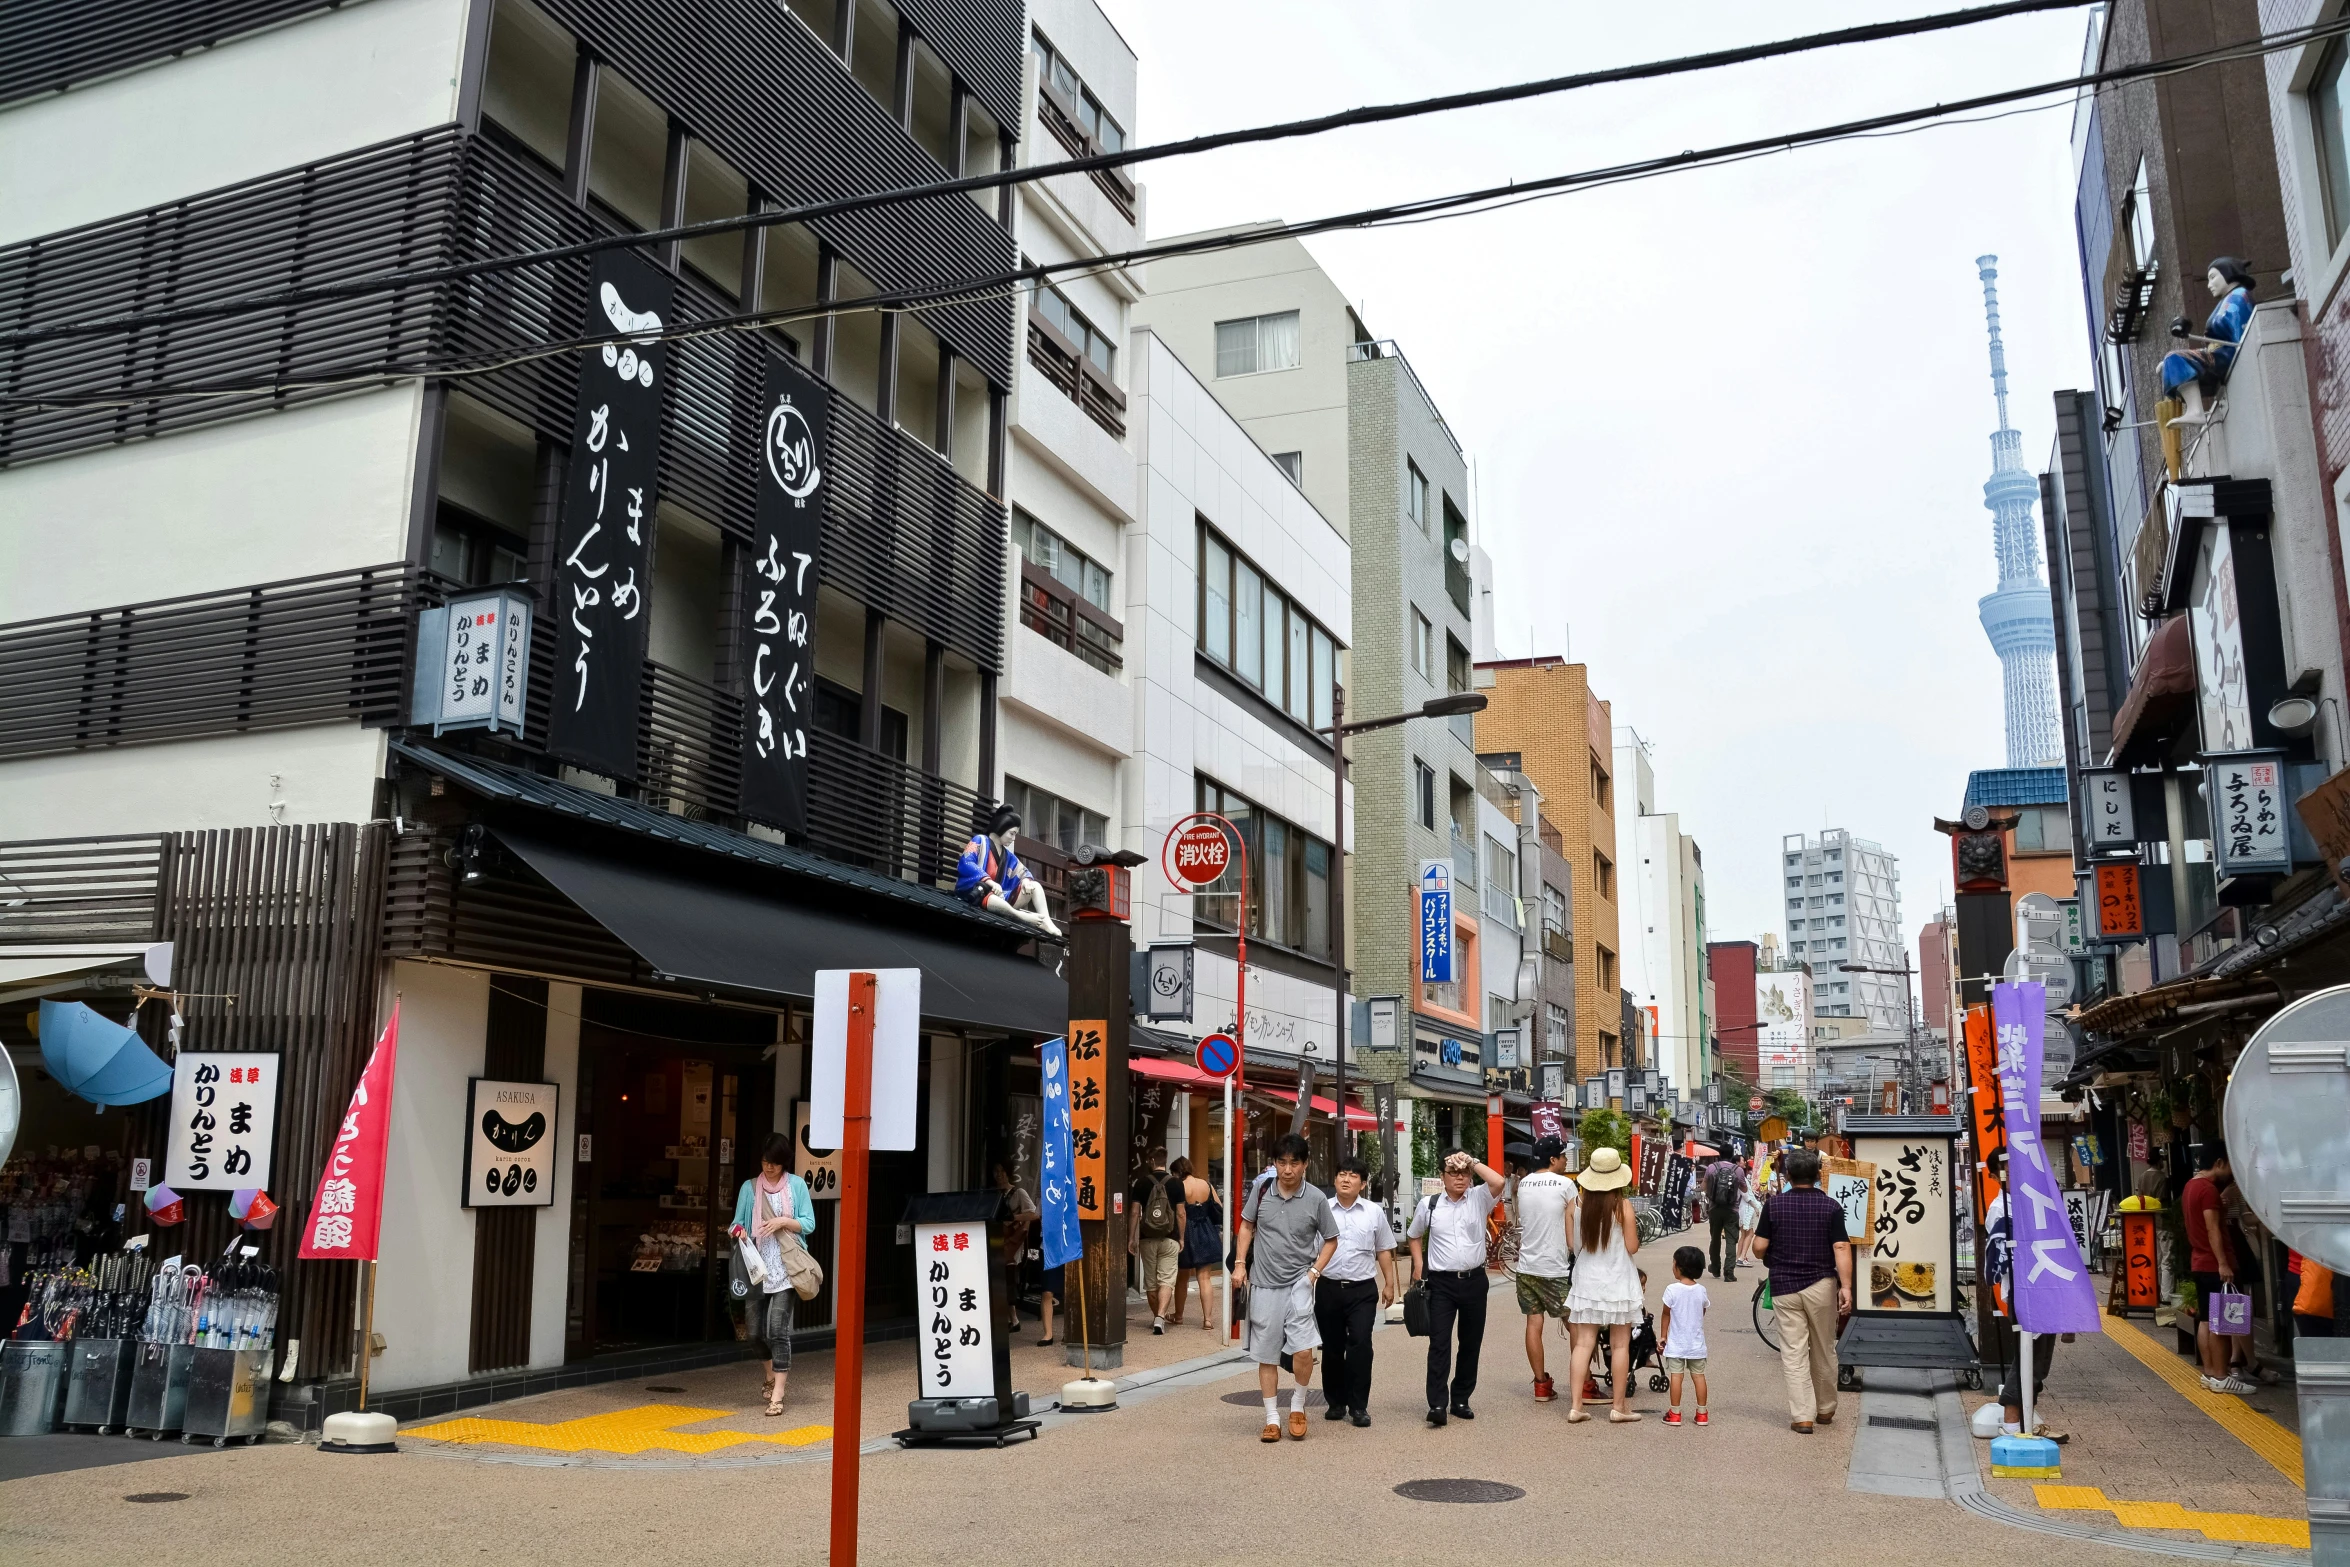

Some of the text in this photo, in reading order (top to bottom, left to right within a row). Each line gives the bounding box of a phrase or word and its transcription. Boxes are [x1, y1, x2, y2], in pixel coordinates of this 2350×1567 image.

[612, 487, 643, 621] まめ
[452, 615, 473, 702] かりんとう
[471, 642, 490, 697] まめ
[503, 612, 520, 705] かりんころん
[753, 534, 787, 761] ふろしき
[784, 551, 812, 761] てぬぐい
[2103, 779, 2122, 836] にしだ
[2226, 772, 2257, 857] 与ろゐ屋
[2256, 789, 2276, 836] らめん
[1179, 842, 1225, 866] 消火栓
[1196, 832, 1220, 840] HYDRANT
[1437, 894, 1448, 957] フォーティネット
[2067, 904, 2080, 946] 神戸の靴
[2102, 894, 2122, 931] のぶ
[2122, 867, 2138, 931] ステーキハウス
[1425, 897, 1437, 979] パソコンスクール
[2063, 947, 2088, 955] ヴェニス
[1275, 1021, 1295, 1043] シューズ
[1793, 974, 1804, 1040] うさぎカフェ
[230, 1067, 260, 1084] 浅草
[496, 1091, 536, 1104] ASAKUSA
[188, 1062, 220, 1181] かりんとう
[223, 1101, 252, 1176] まめ
[492, 1123, 536, 1147] かりん
[1069, 1030, 1102, 1212] 伝法院通
[2132, 1123, 2146, 1158] SALE
[489, 1170, 535, 1188] ころん
[1851, 1179, 1869, 1221] 冷し
[1893, 1144, 1929, 1225] ざる
[1928, 1148, 1943, 1198] 浅草名代
[1873, 1169, 1900, 1258] らーめん
[2132, 1224, 2147, 1247] 浅草
[932, 1232, 970, 1252] 浅草
[2130, 1253, 2154, 1297] のぶ
[929, 1260, 953, 1388] かりんとう
[958, 1287, 981, 1347] まめ
